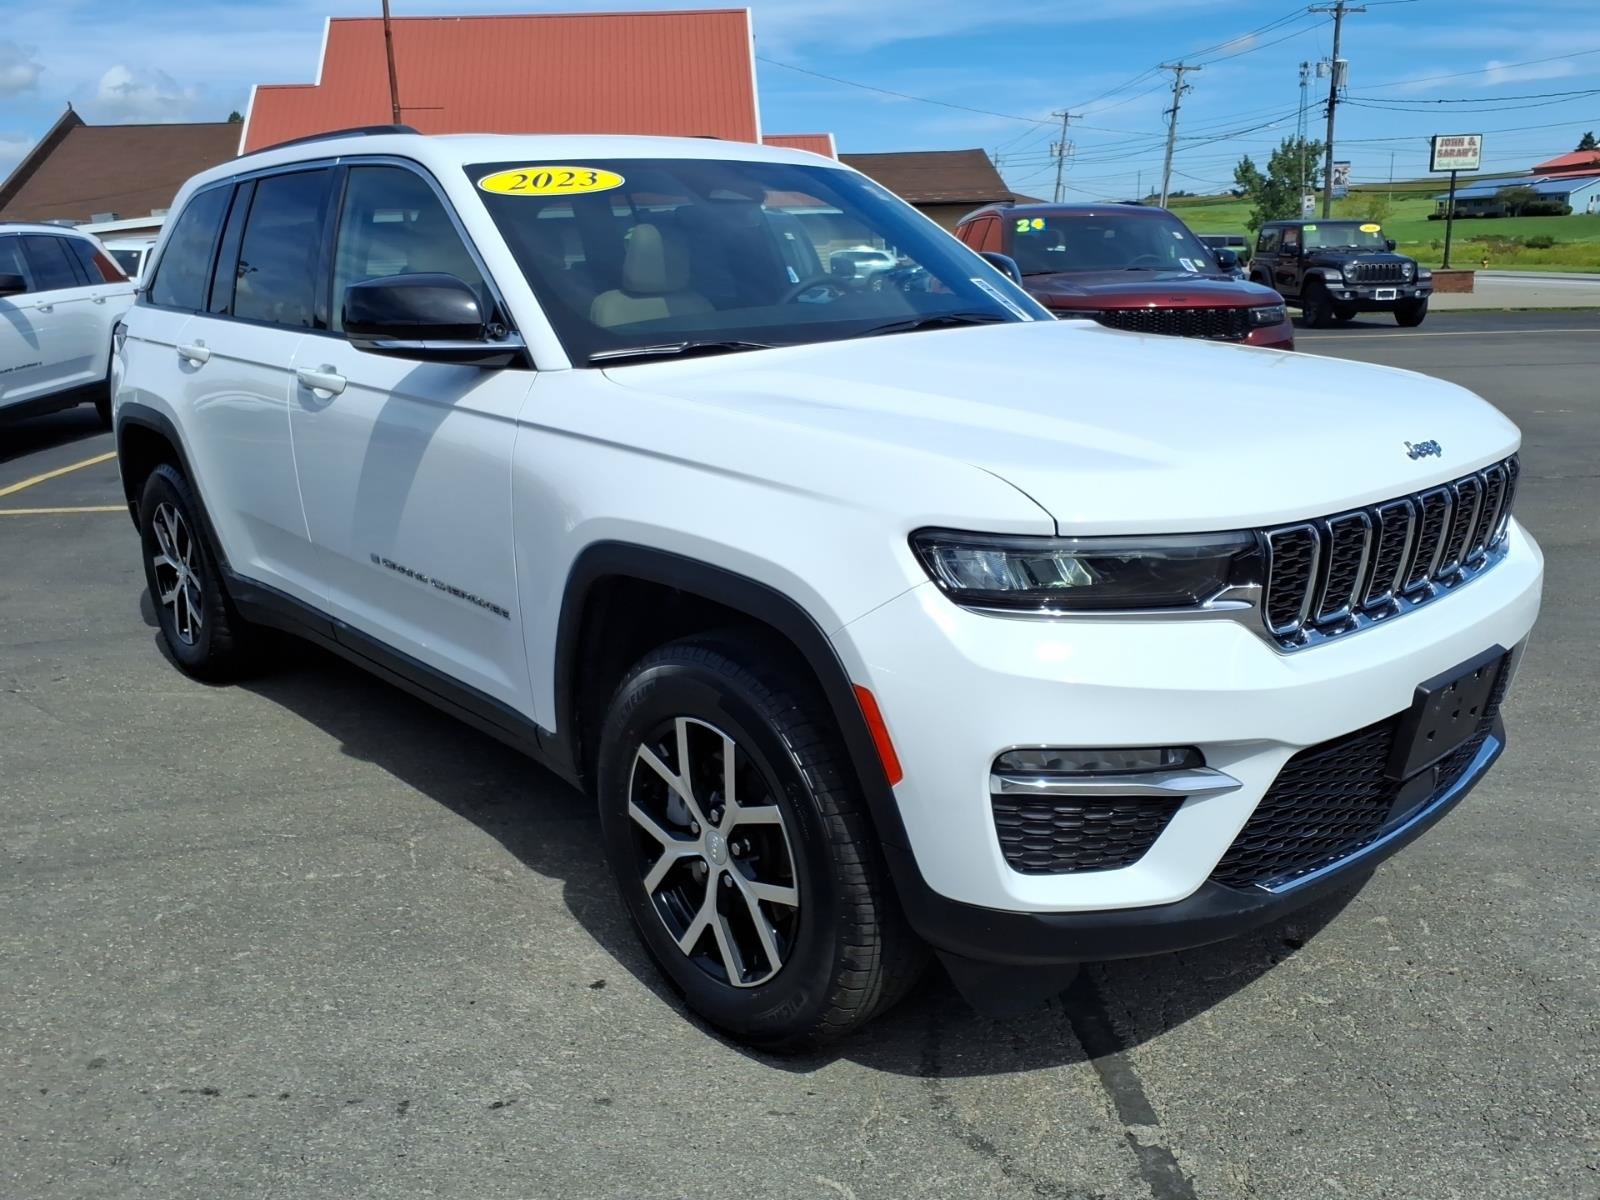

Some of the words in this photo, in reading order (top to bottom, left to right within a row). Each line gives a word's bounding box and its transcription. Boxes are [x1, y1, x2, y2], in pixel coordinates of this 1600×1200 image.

[1439, 137, 1465, 148] JOHN
[1468, 136, 1476, 146] &
[508, 171, 598, 191] 2023
